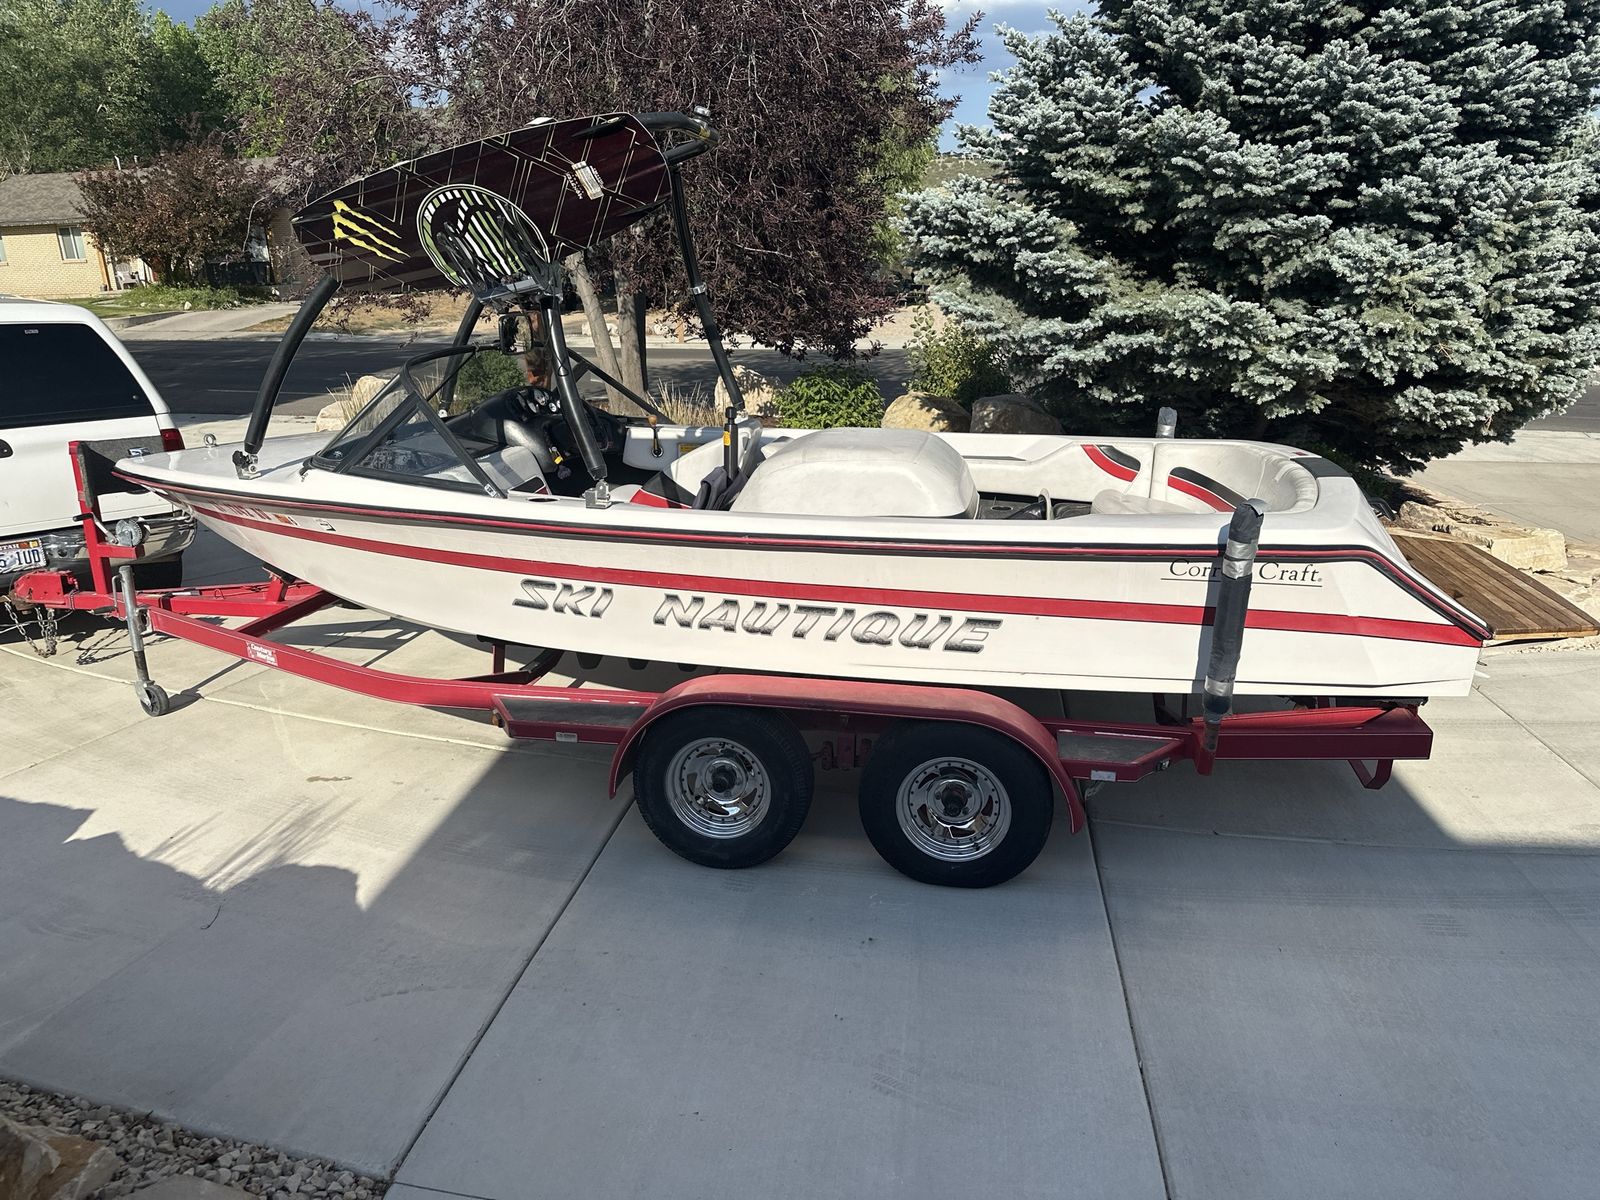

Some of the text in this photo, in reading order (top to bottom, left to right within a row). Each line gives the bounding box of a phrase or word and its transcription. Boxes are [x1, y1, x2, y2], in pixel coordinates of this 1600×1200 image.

[1169, 558, 1319, 582] Corr Craft
[512, 579, 1003, 654] SKI NAUTIQUE
